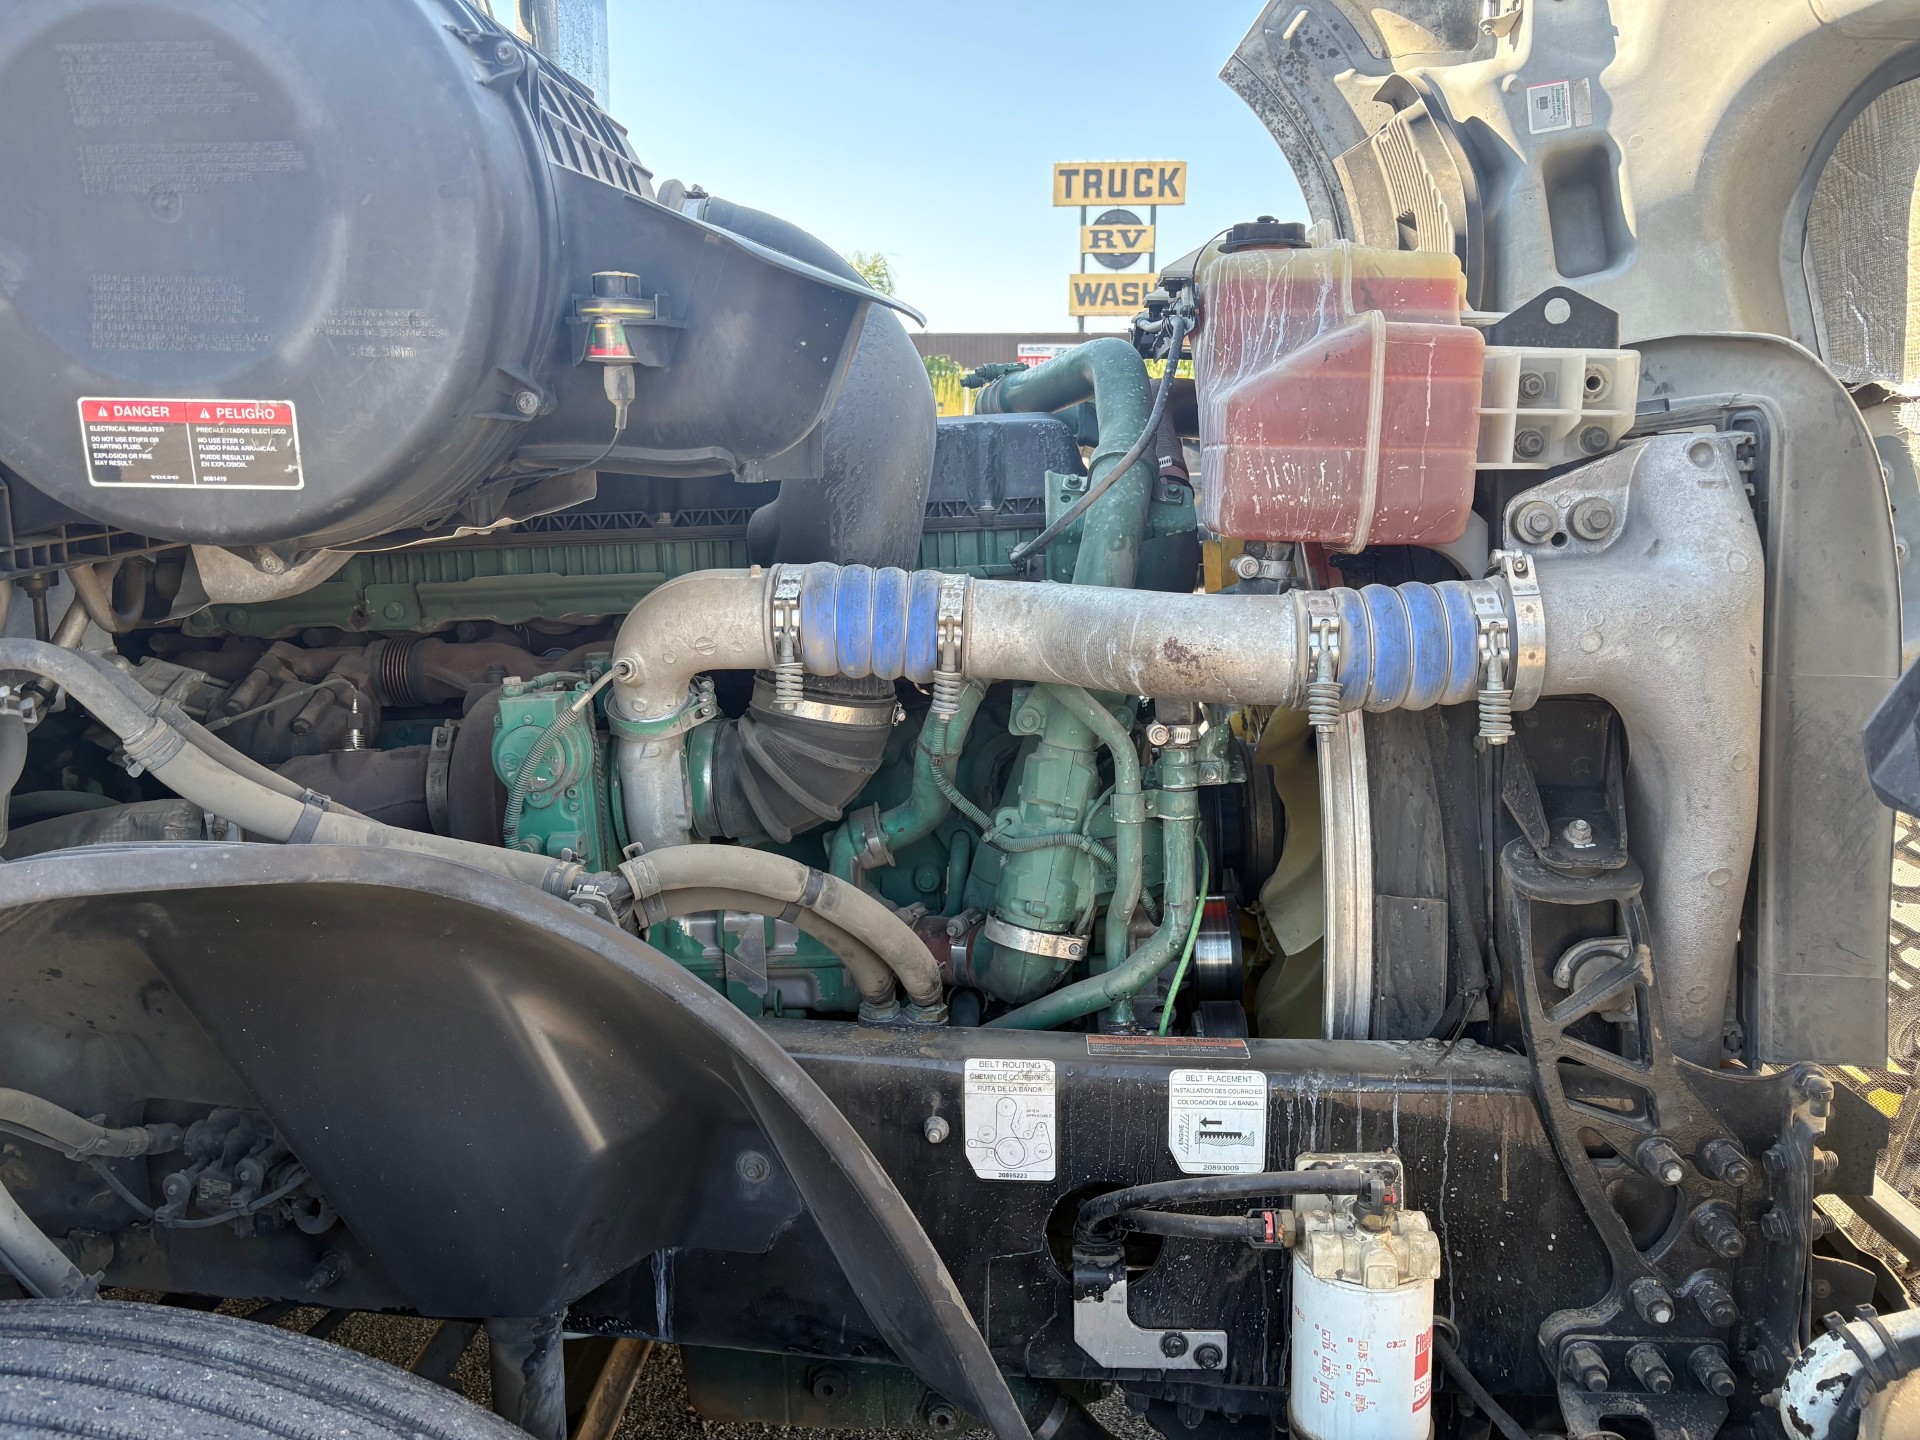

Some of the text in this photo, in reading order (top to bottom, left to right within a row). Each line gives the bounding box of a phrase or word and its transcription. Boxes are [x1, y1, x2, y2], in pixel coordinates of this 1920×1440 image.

[1058, 167, 1181, 198] TRUCK
[1088, 229, 1147, 249] RV
[113, 406, 170, 418] DANGER
[216, 408, 275, 420] PELIGRO
[1002, 1061, 1041, 1069] ROUTING
